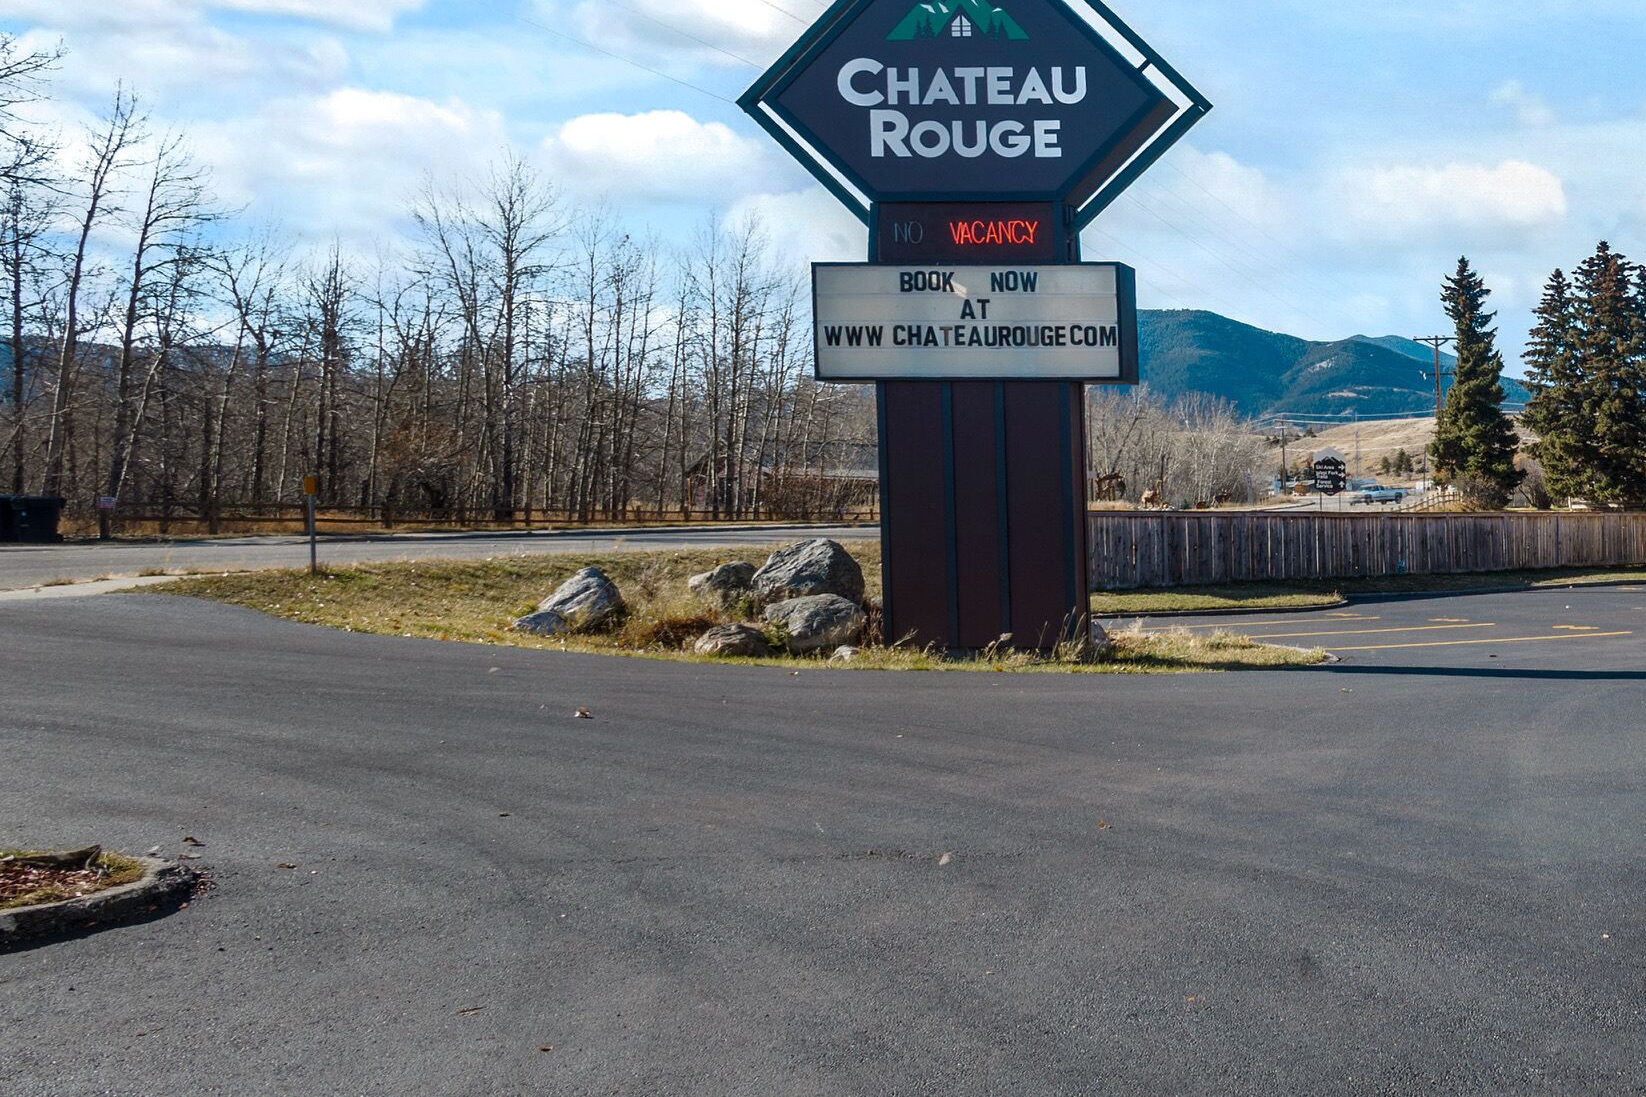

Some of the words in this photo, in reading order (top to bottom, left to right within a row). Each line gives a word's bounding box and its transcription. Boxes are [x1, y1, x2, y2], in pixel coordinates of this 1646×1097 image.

[837, 57, 1087, 107] CHATEAU
[869, 109, 1062, 158] ROUGE
[894, 221, 923, 244] NO
[950, 220, 1038, 244] VACANCY
[900, 270, 955, 293] BOOK
[991, 270, 1038, 292] NOW
[960, 299, 990, 319] AT
[823, 325, 884, 347] WWW
